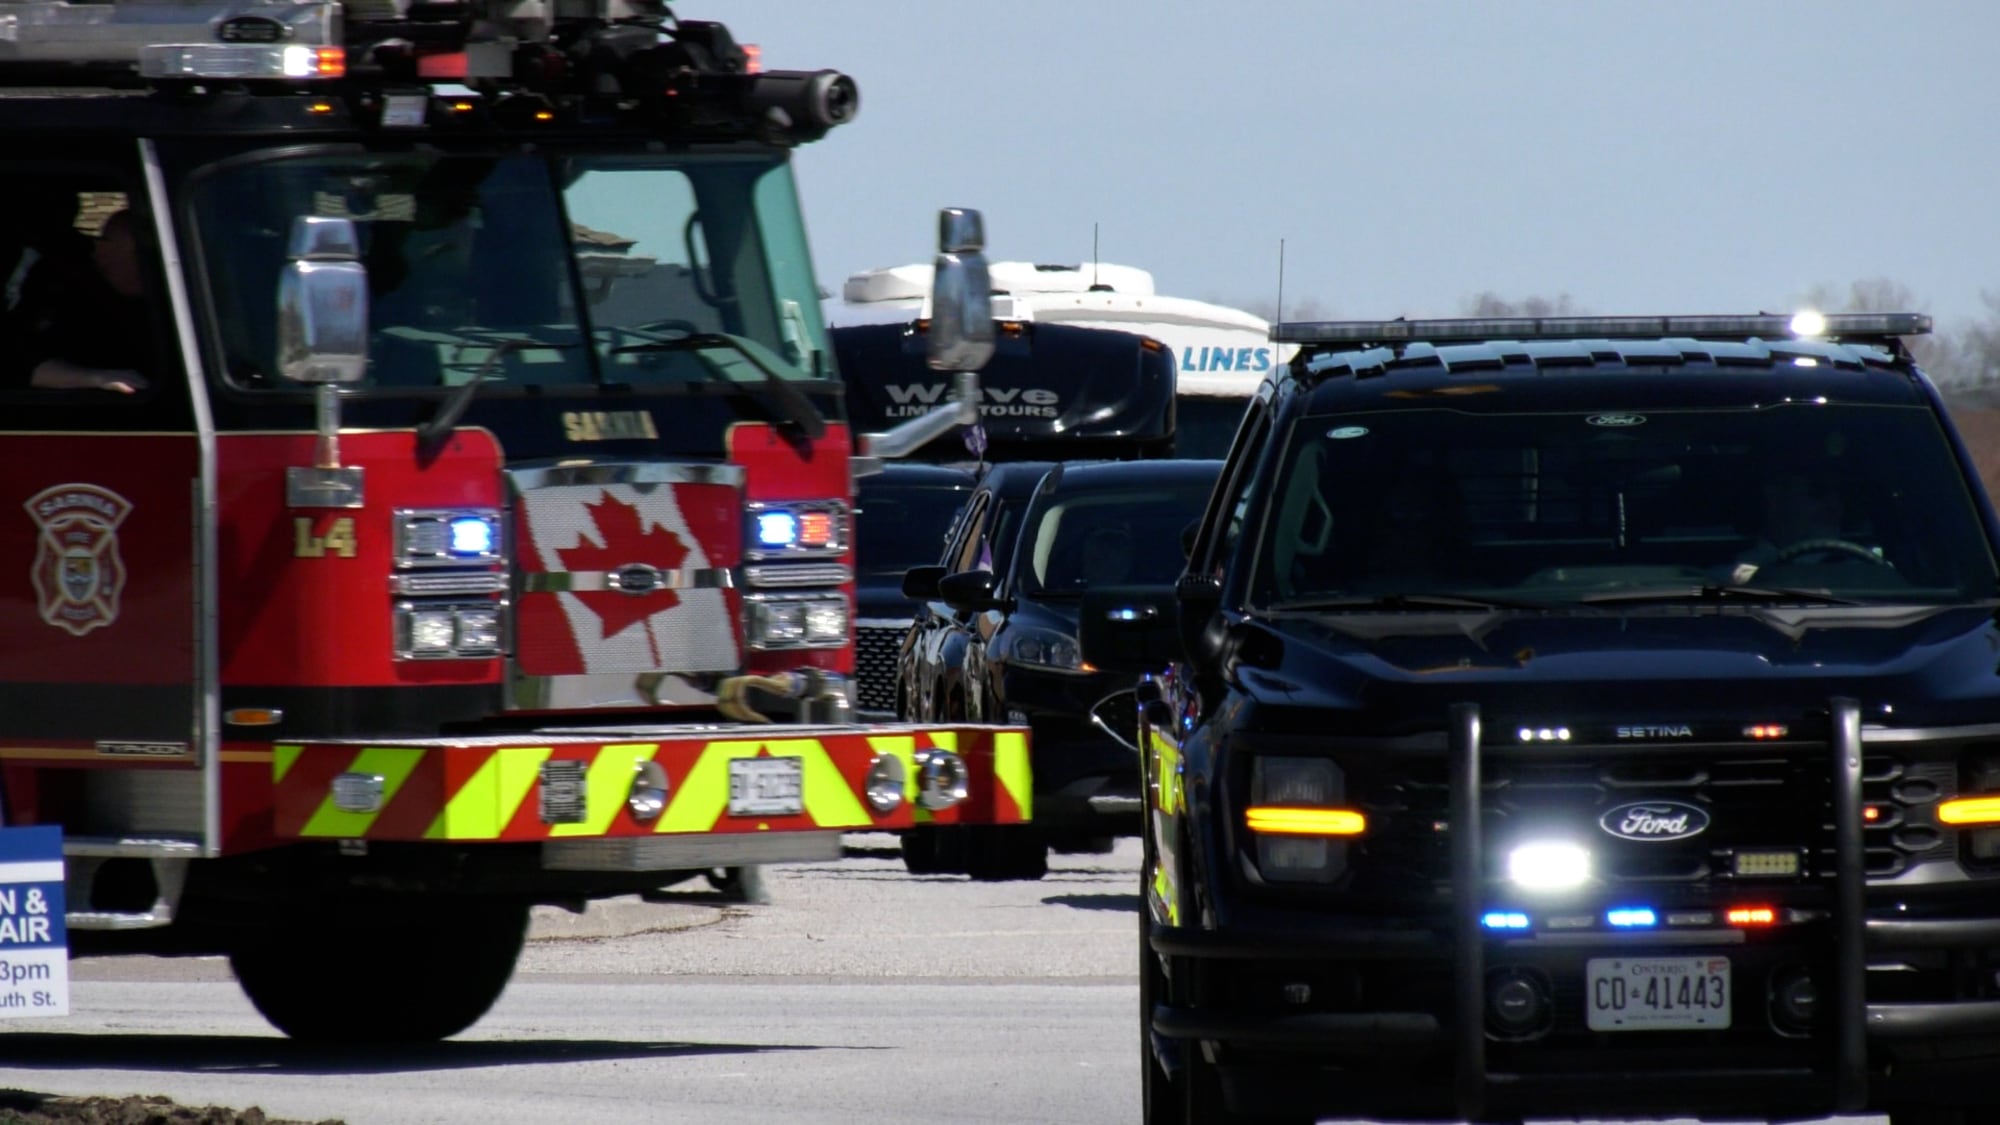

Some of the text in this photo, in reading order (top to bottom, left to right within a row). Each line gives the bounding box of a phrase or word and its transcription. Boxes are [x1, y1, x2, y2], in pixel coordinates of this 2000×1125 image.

[1181, 346, 1271, 371] LINES
[978, 405, 1058, 418] TOURS
[294, 517, 355, 558] L4
[1617, 725, 1693, 738] SETINA
[1620, 806, 1689, 834] Ford
[25, 888, 48, 914] &
[0, 917, 51, 943] AIR
[0, 960, 50, 985] 3pm
[32, 990, 56, 1007] St.
[1595, 975, 1724, 1010] CD 41443
